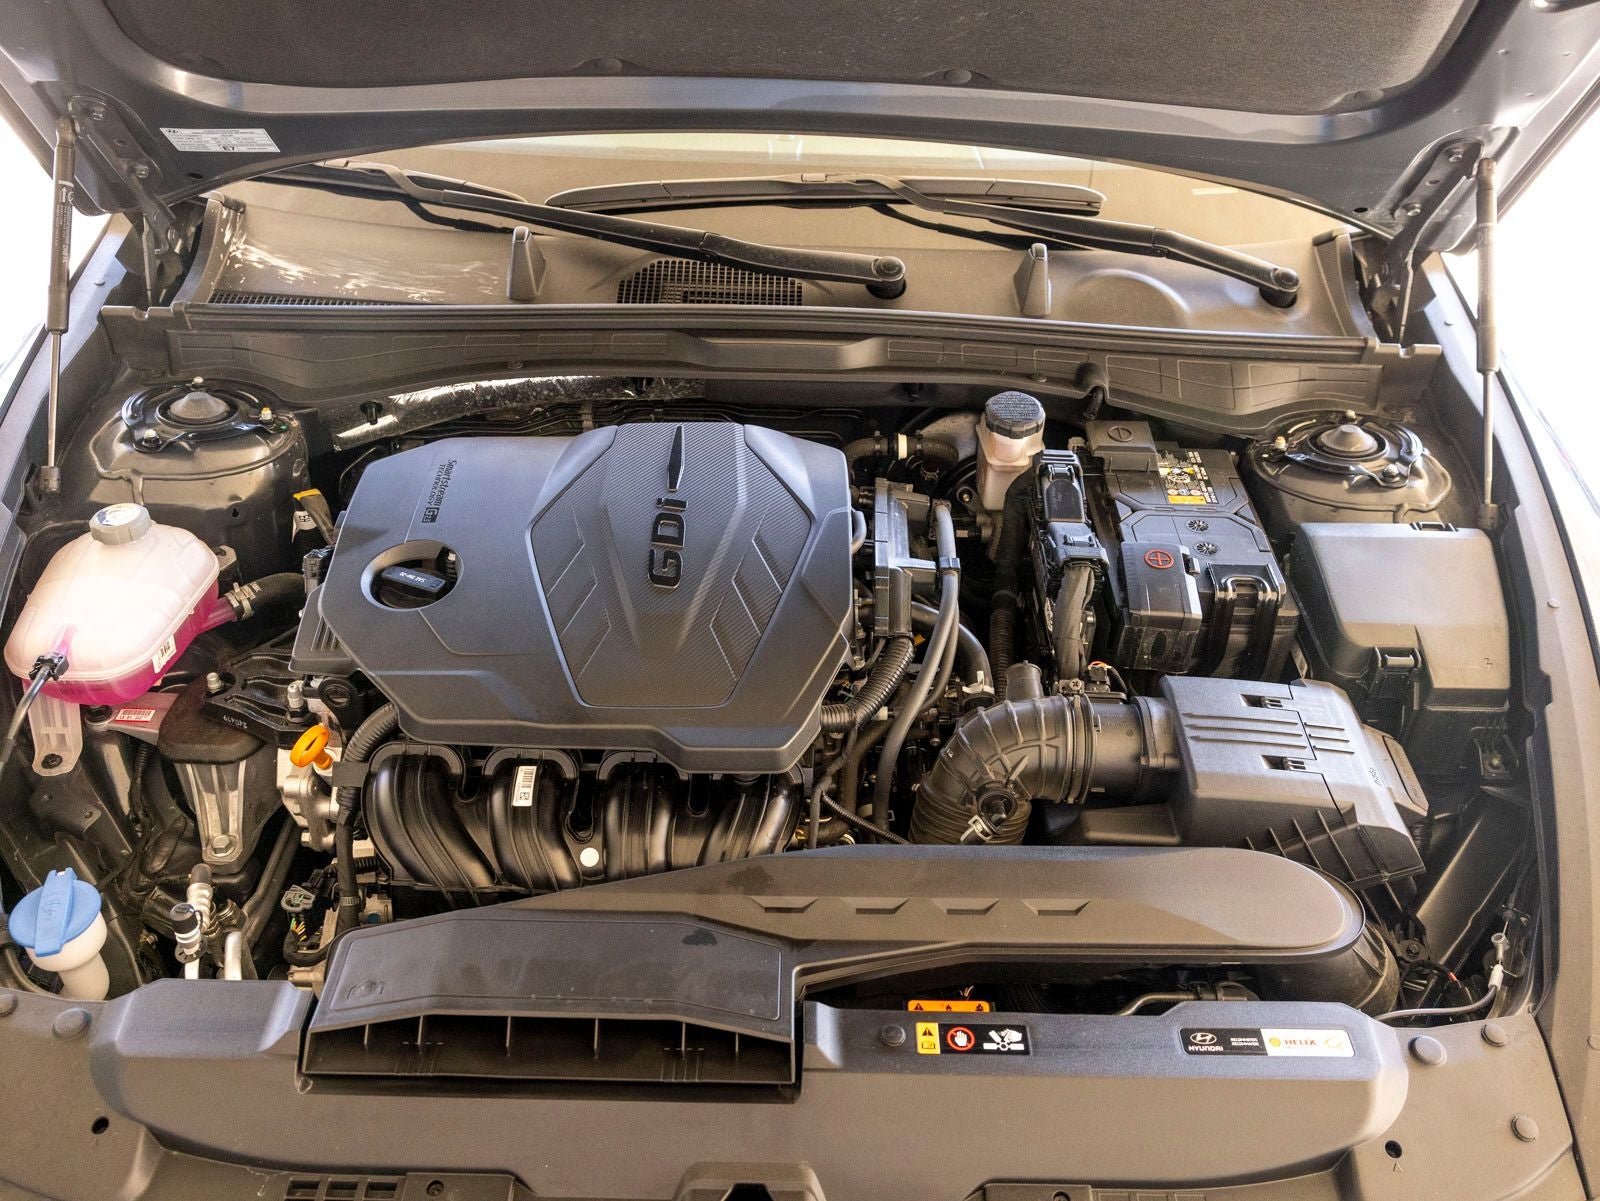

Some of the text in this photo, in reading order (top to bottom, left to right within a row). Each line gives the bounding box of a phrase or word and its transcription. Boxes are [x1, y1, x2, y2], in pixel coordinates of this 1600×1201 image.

[427, 464, 447, 506] TECHNOLOGY
[433, 459, 457, 507] Smartstream
[648, 497, 689, 590] GDi
